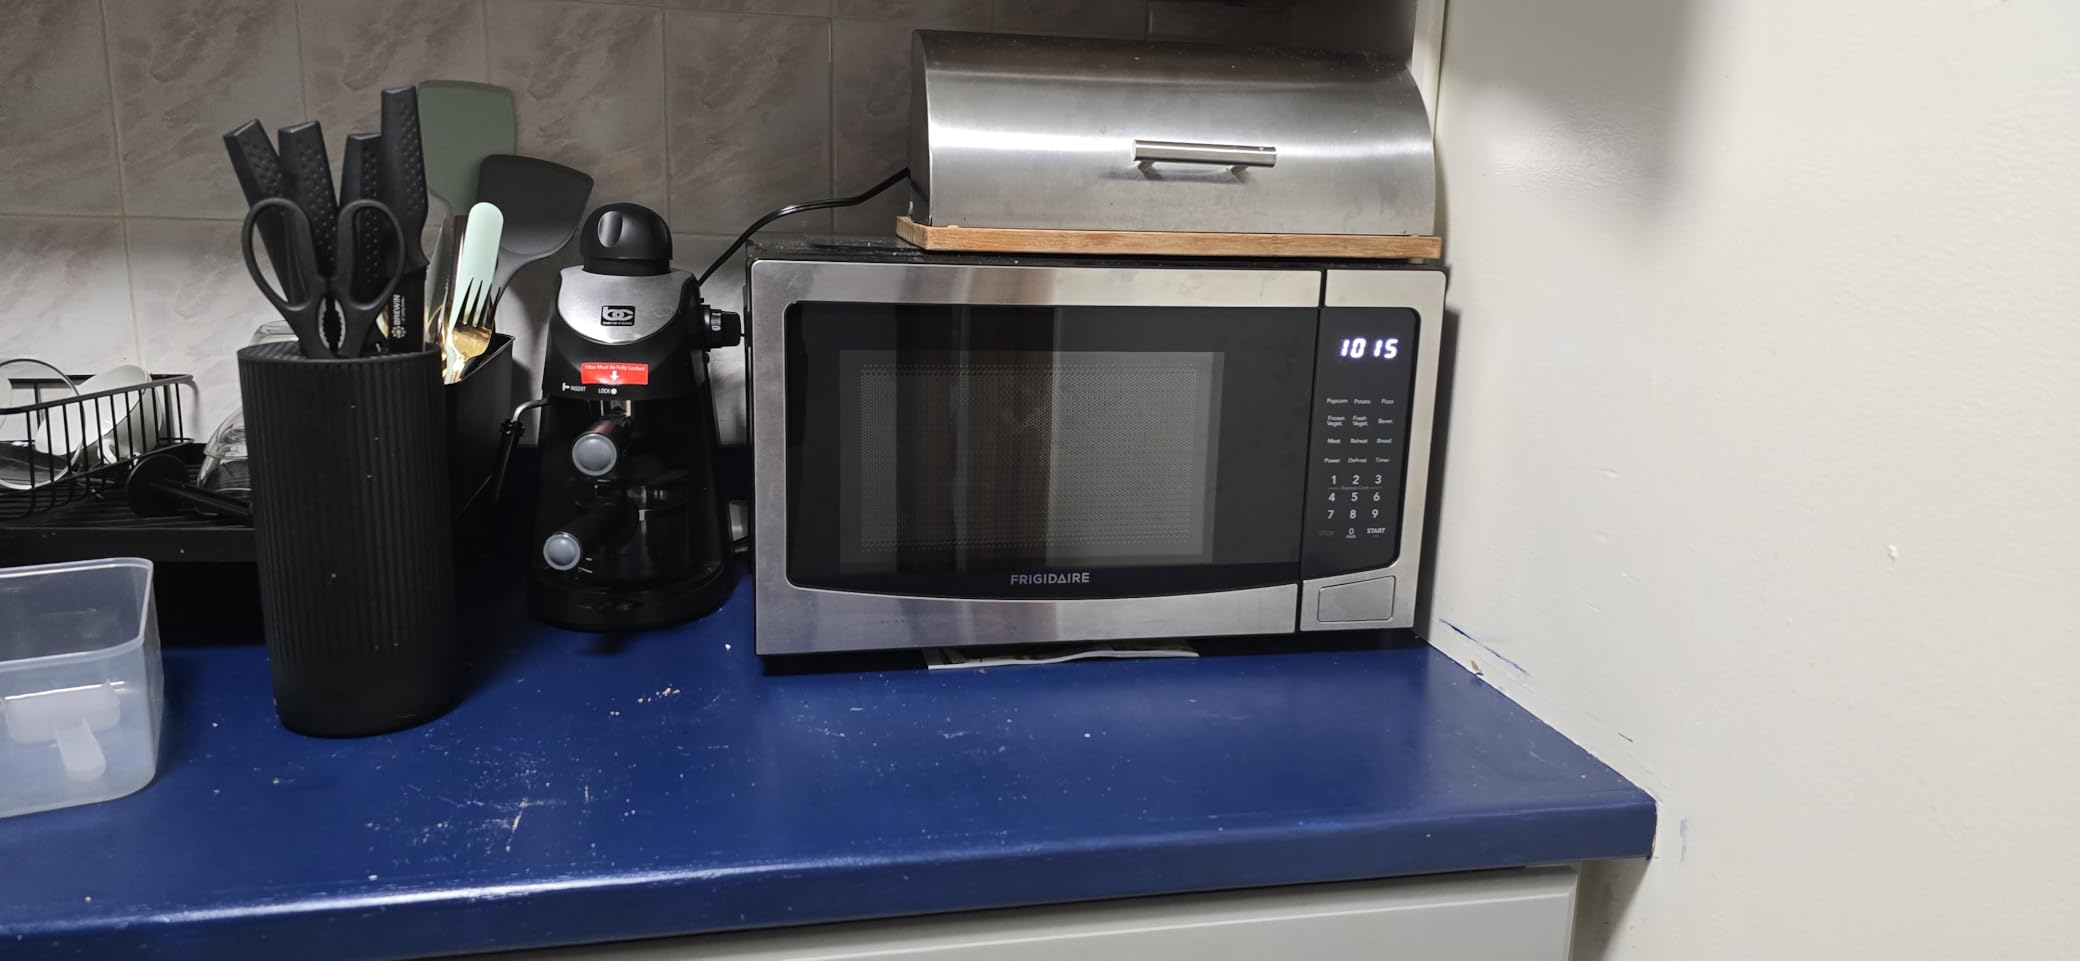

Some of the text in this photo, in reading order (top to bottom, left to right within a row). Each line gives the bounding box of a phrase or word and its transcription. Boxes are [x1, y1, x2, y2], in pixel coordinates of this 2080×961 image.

[1331, 474, 1337, 485] 1
[1352, 474, 1360, 485] 2
[1375, 474, 1382, 485] 3
[1328, 492, 1336, 502] 4
[1351, 492, 1359, 502] 5
[1373, 491, 1381, 502] 6
[1327, 509, 1335, 520] 7
[1349, 509, 1357, 519] 8
[1371, 508, 1379, 519] 9
[1348, 527, 1355, 535] 0
[1010, 572, 1090, 585] FRIGIDAIRE
